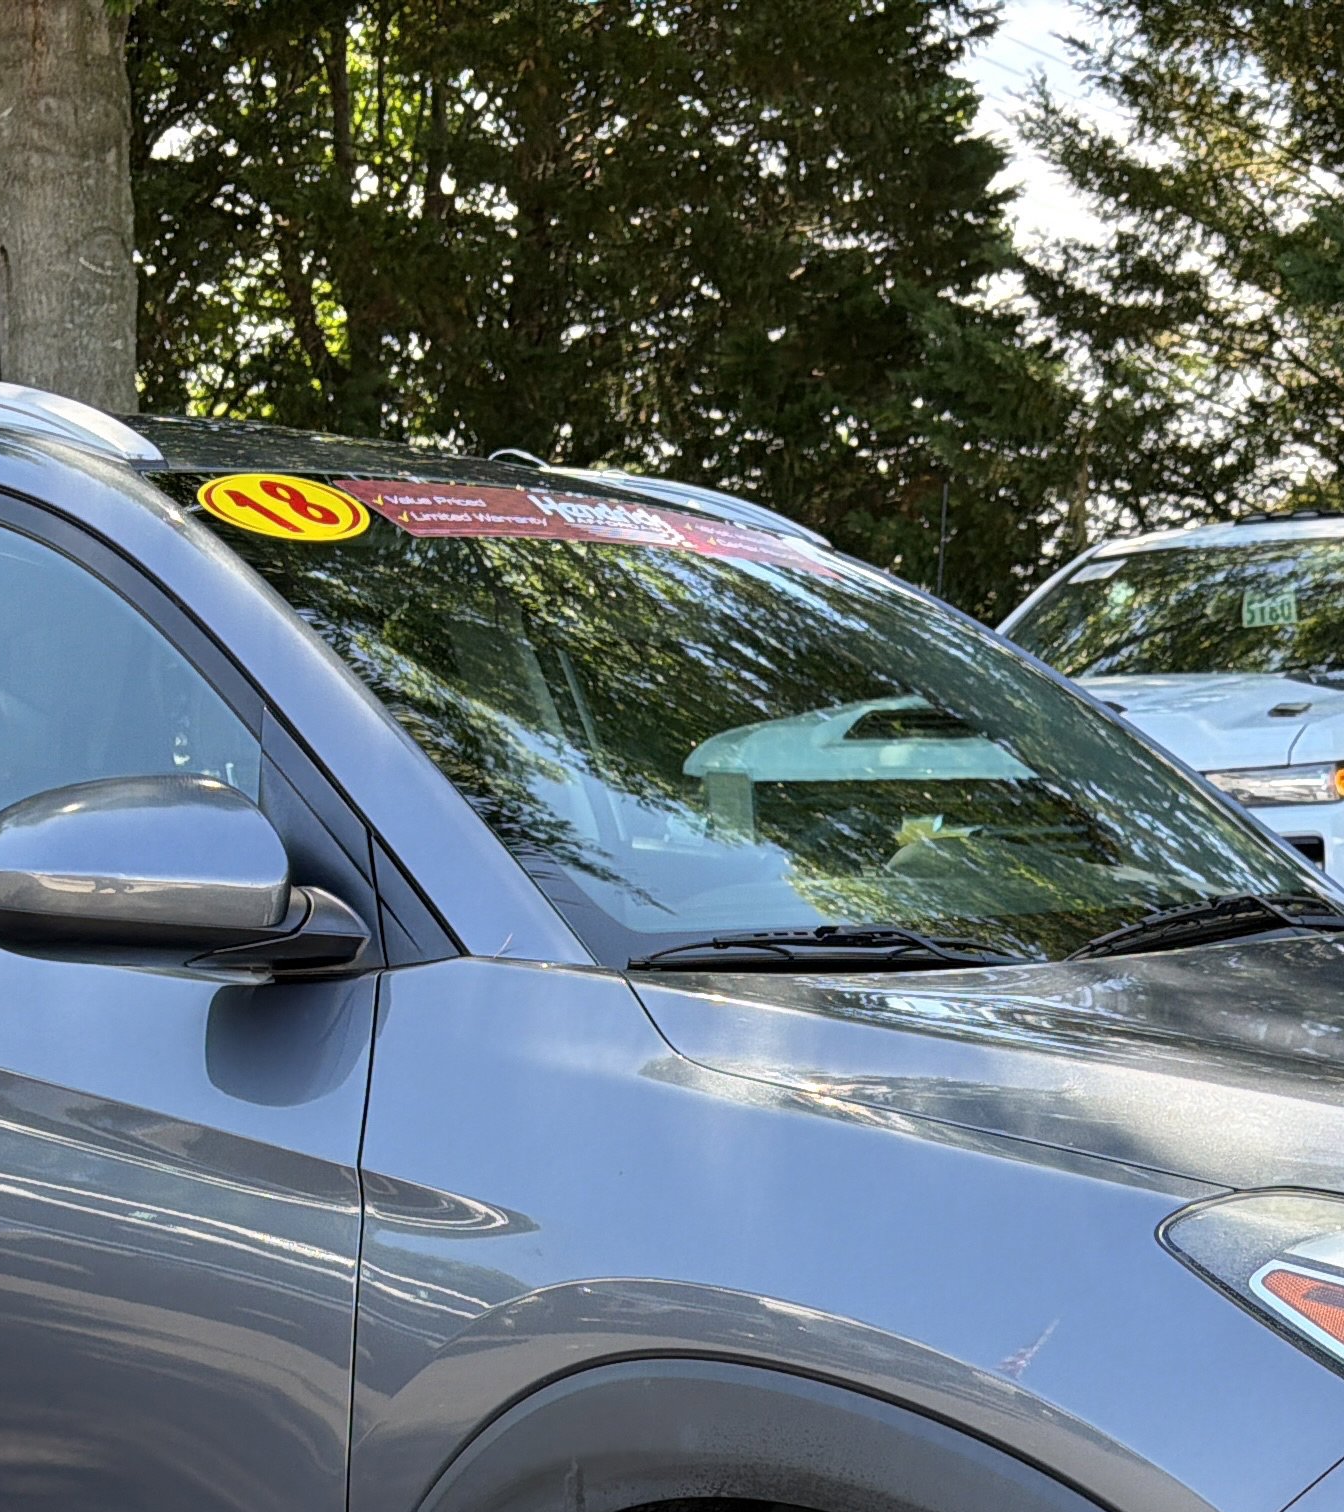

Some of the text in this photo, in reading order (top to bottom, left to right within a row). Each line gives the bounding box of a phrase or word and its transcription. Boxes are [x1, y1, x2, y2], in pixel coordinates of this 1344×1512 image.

[223, 480, 340, 532] 18
[384, 494, 487, 507] Value Priced
[410, 511, 548, 527] Limited Warranty
[527, 494, 685, 544] Hendrick
